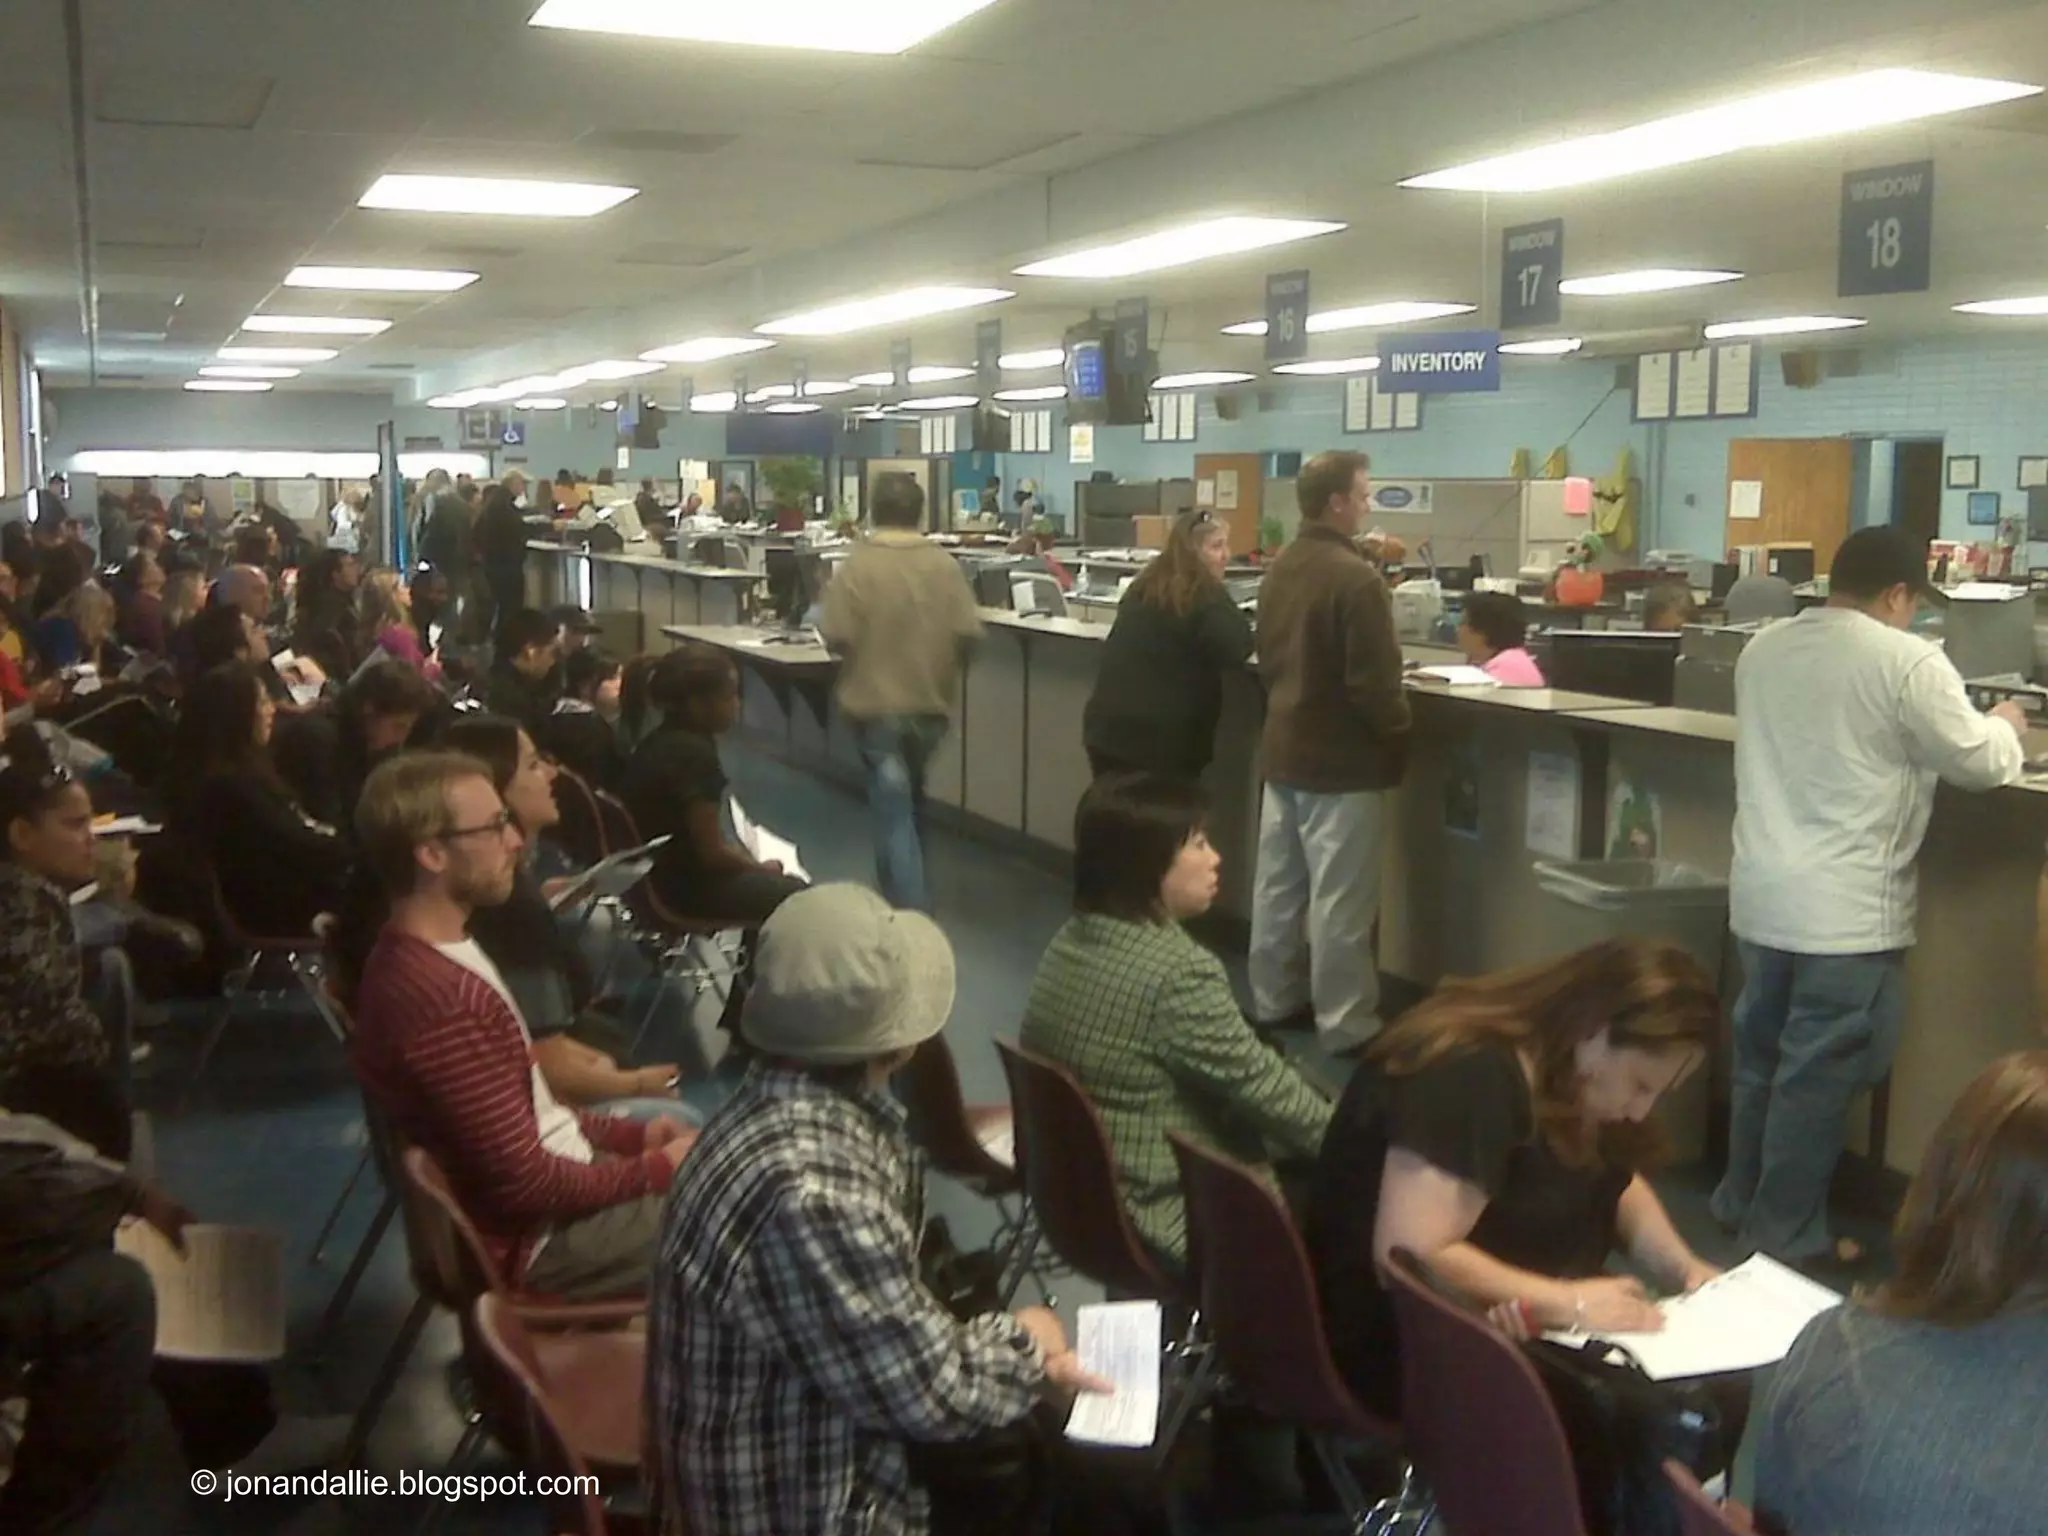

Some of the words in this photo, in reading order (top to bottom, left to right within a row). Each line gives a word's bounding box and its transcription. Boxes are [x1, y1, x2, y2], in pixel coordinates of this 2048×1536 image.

[1850, 173, 1923, 200] WINDOW
[1866, 217, 1901, 269] 18
[1518, 265, 1543, 306] 17
[1277, 308, 1294, 342] 16
[1392, 352, 1486, 372] INVENTORY
